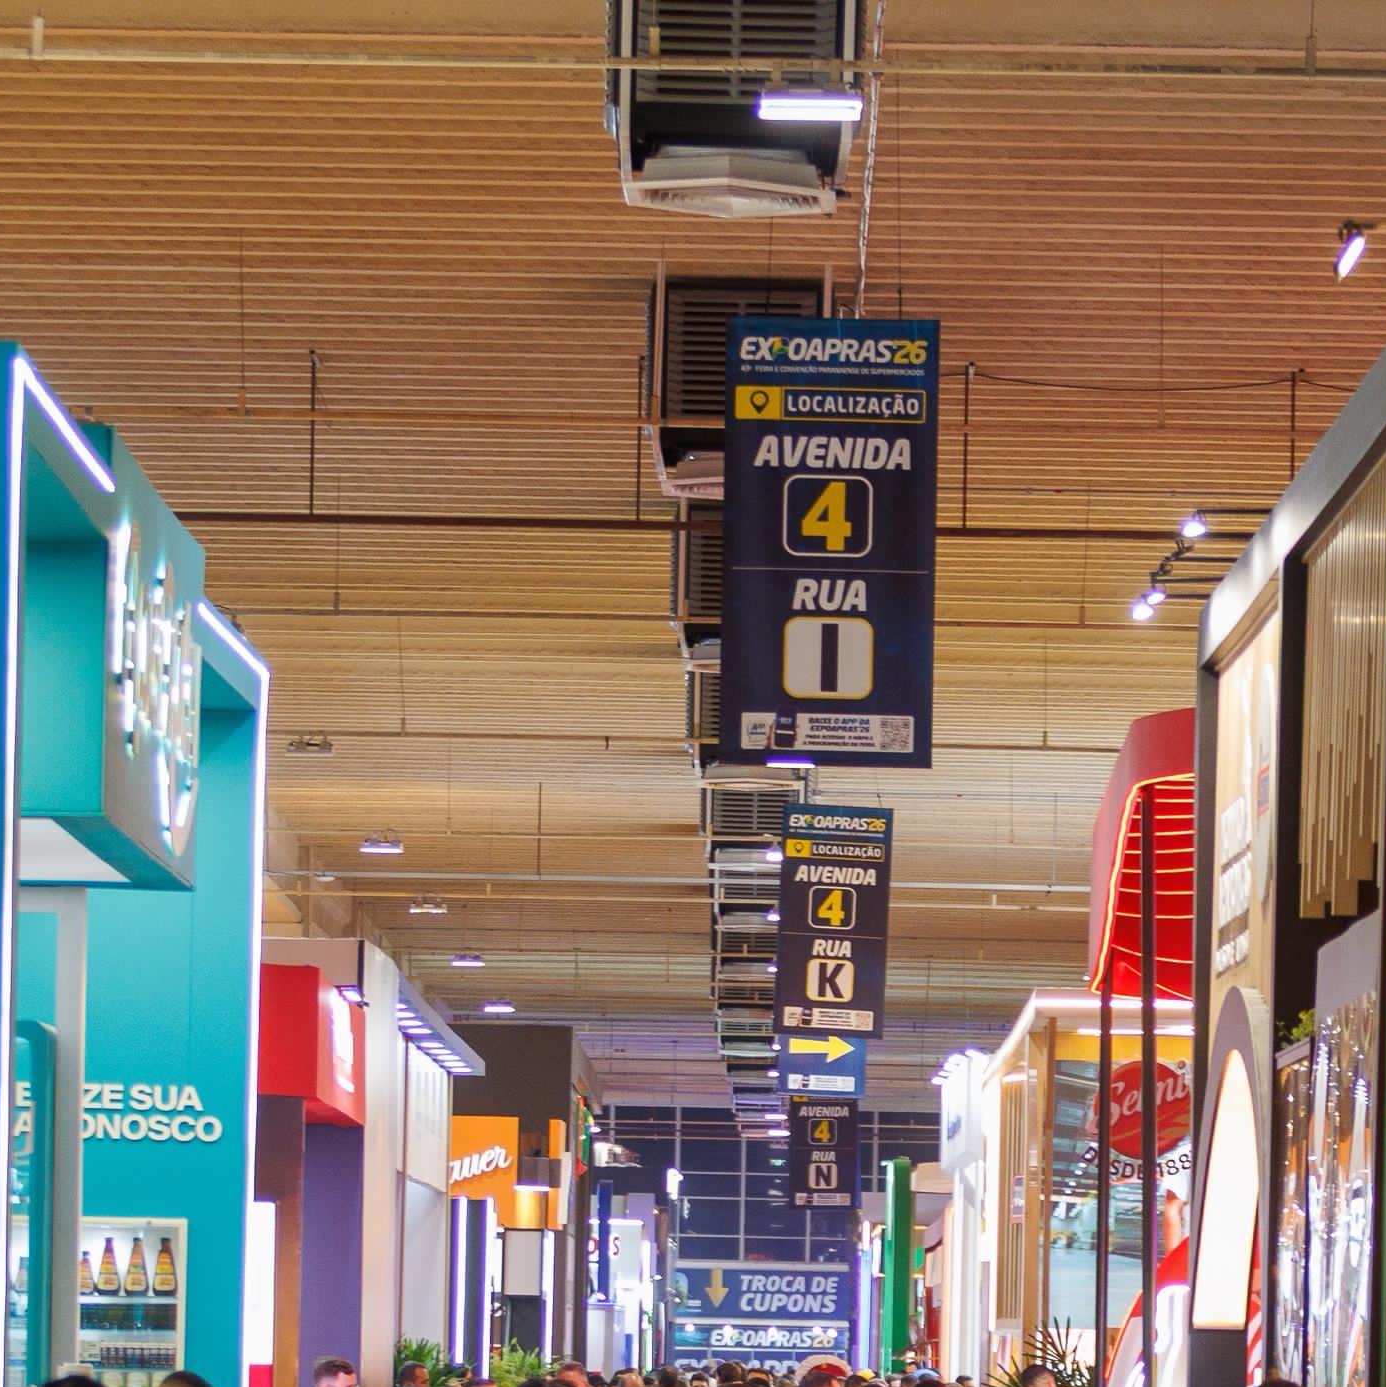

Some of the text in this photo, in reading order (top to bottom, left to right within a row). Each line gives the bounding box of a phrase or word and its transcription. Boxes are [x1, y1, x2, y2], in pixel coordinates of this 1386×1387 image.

[787, 394, 920, 418] LOCALIZAÇÃO
[754, 435, 911, 471] AVENIDA
[801, 481, 852, 551] 4
[791, 578, 867, 611] RUA
[821, 622, 839, 693] I
[813, 845, 882, 858] LOCALIZAÇÃO
[795, 864, 877, 886] AVENIDA
[817, 889, 845, 926] 4
[812, 938, 852, 958] RUA
[817, 963, 845, 999] K
[129, 1083, 204, 1111] SUA
[1085, 1060, 1191, 1134] Semi
[799, 1106, 849, 1117] AVENIDA
[81, 1113, 223, 1142] ONOSCO
[814, 1120, 831, 1142] 4
[449, 1145, 513, 1184] auer
[812, 1151, 836, 1161] RUA
[815, 1165, 832, 1186] N
[740, 1275, 839, 1294] TROCA DE
[740, 1293, 837, 1314] CUPONS
